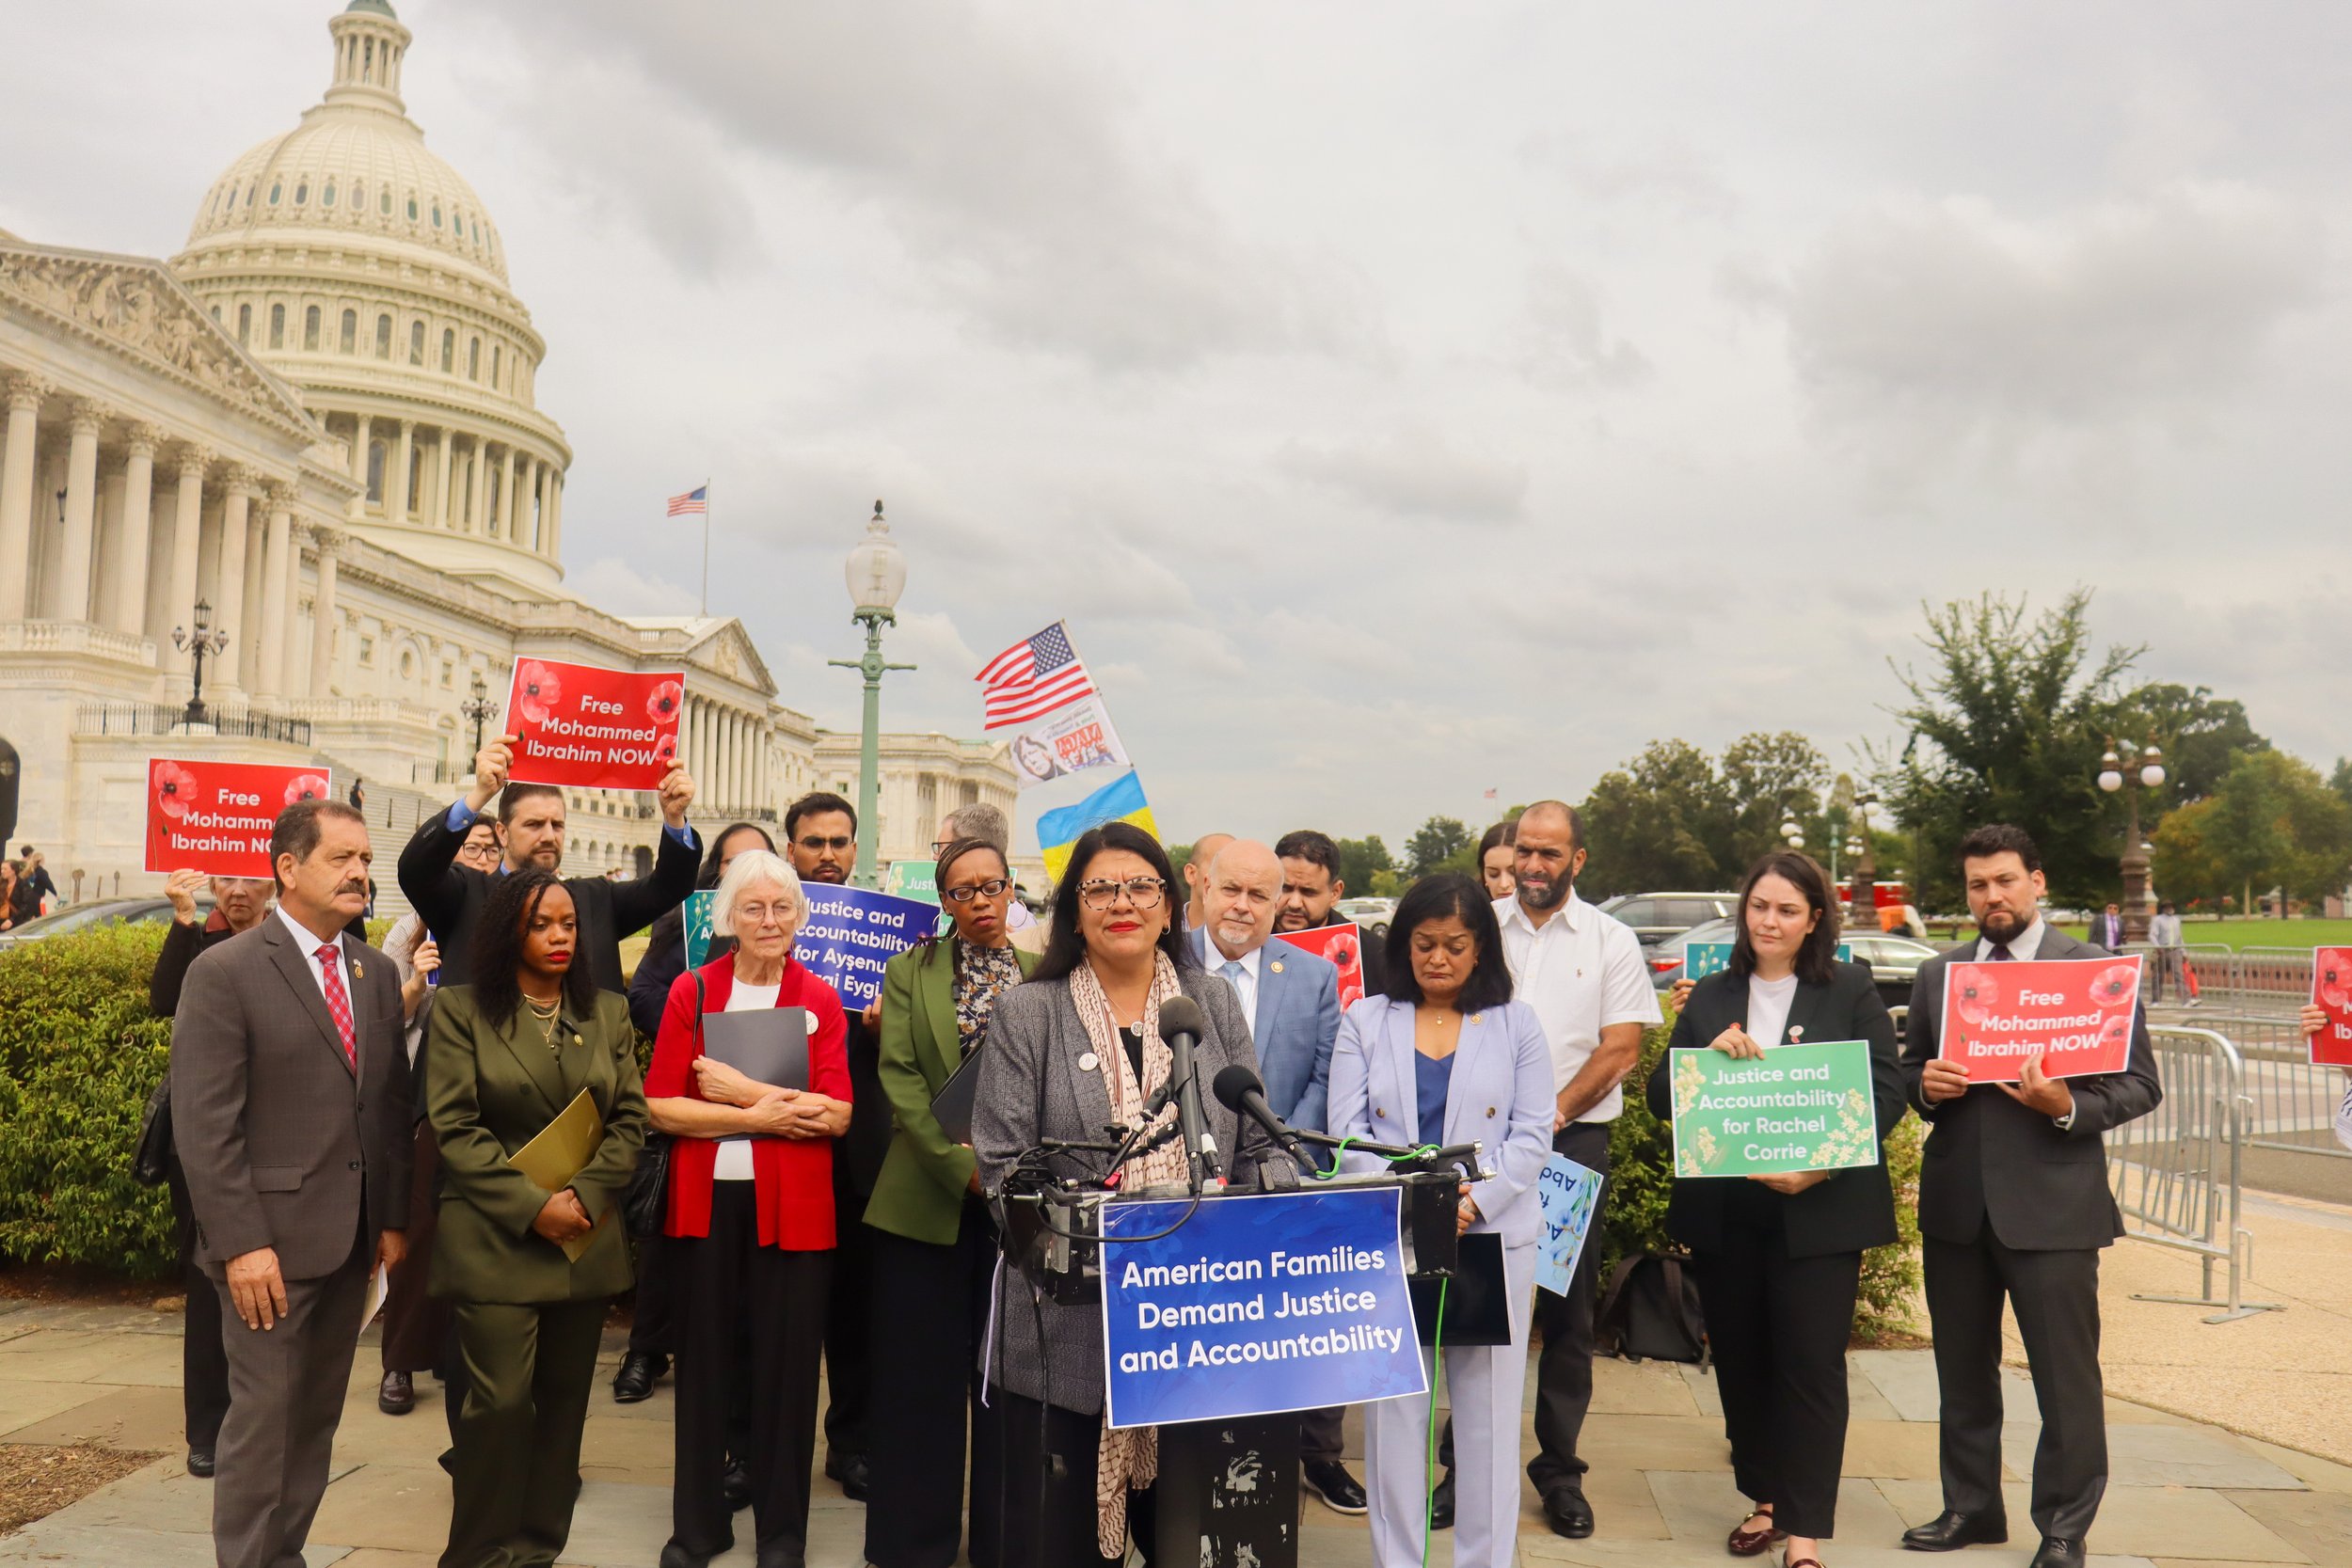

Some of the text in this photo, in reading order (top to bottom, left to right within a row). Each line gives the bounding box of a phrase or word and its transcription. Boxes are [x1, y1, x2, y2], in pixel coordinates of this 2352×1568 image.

[580, 694, 624, 716] Free
[540, 717, 657, 742] Mohammed
[527, 739, 659, 767] Ibrahim NOW
[217, 788, 261, 806] Free
[183, 811, 277, 831] Mohamm
[171, 832, 246, 853] Ibrahim
[906, 877, 938, 891] Justi
[867, 911, 906, 928] and
[795, 925, 914, 953] ccountability
[794, 943, 887, 974] for Ayşenu
[843, 974, 881, 1000] Eygi
[2018, 990, 2065, 1006] Free
[1980, 1009, 2103, 1032] Mohammed
[1967, 1033, 2104, 1057] Ibrahim NOW
[1712, 1064, 1830, 1085] Justice and
[1698, 1088, 1847, 1110] Accountability
[1723, 1115, 1826, 1134] for Rachel
[1743, 1143, 1808, 1161] Corrie
[1120, 1244, 1386, 1289] American Families
[1137, 1287, 1376, 1330] Demand Justice
[1120, 1324, 1403, 1373] and Accountability
